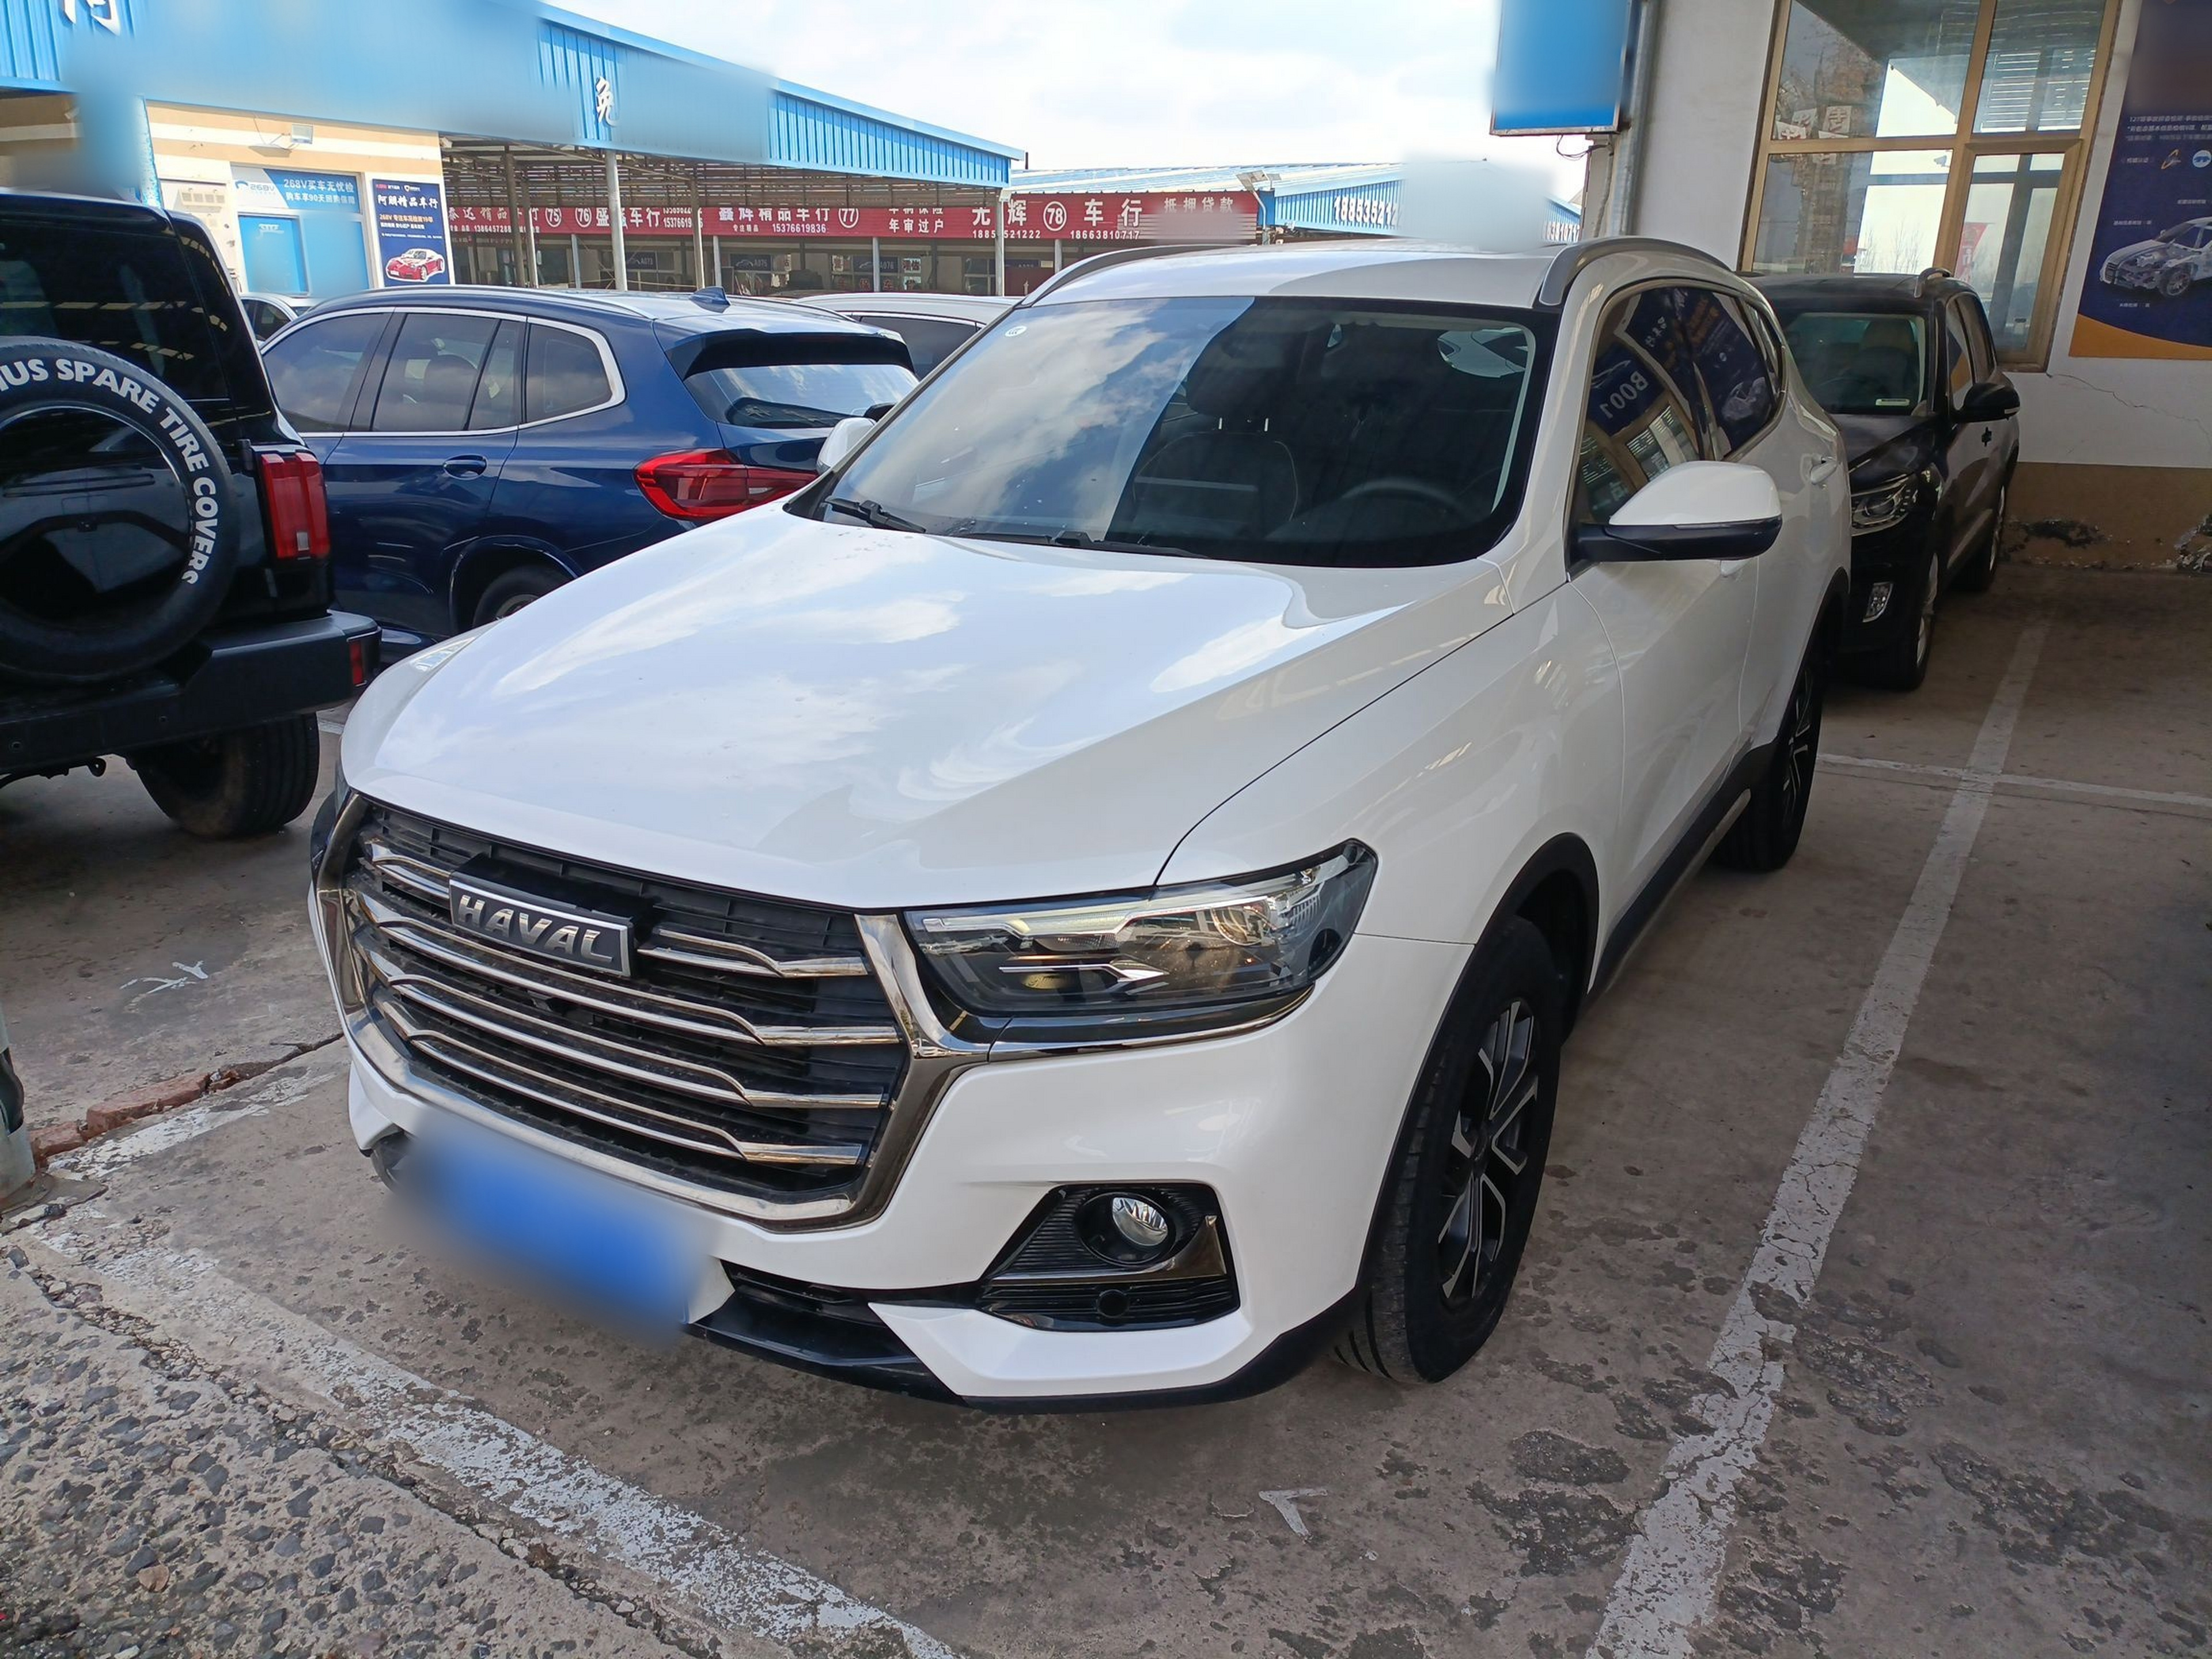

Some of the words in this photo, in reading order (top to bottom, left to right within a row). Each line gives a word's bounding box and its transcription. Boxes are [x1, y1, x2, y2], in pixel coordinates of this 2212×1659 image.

[1084, 199, 1143, 227] 车行
[772, 223, 826, 233] 15376619836
[888, 218, 944, 233] 年审过户
[972, 230, 1041, 239] 1885521222
[1070, 230, 1140, 240] 18663810717
[55, 358, 160, 414] SPARE
[160, 406, 210, 472] TIRE
[458, 894, 613, 963] HAVAL
